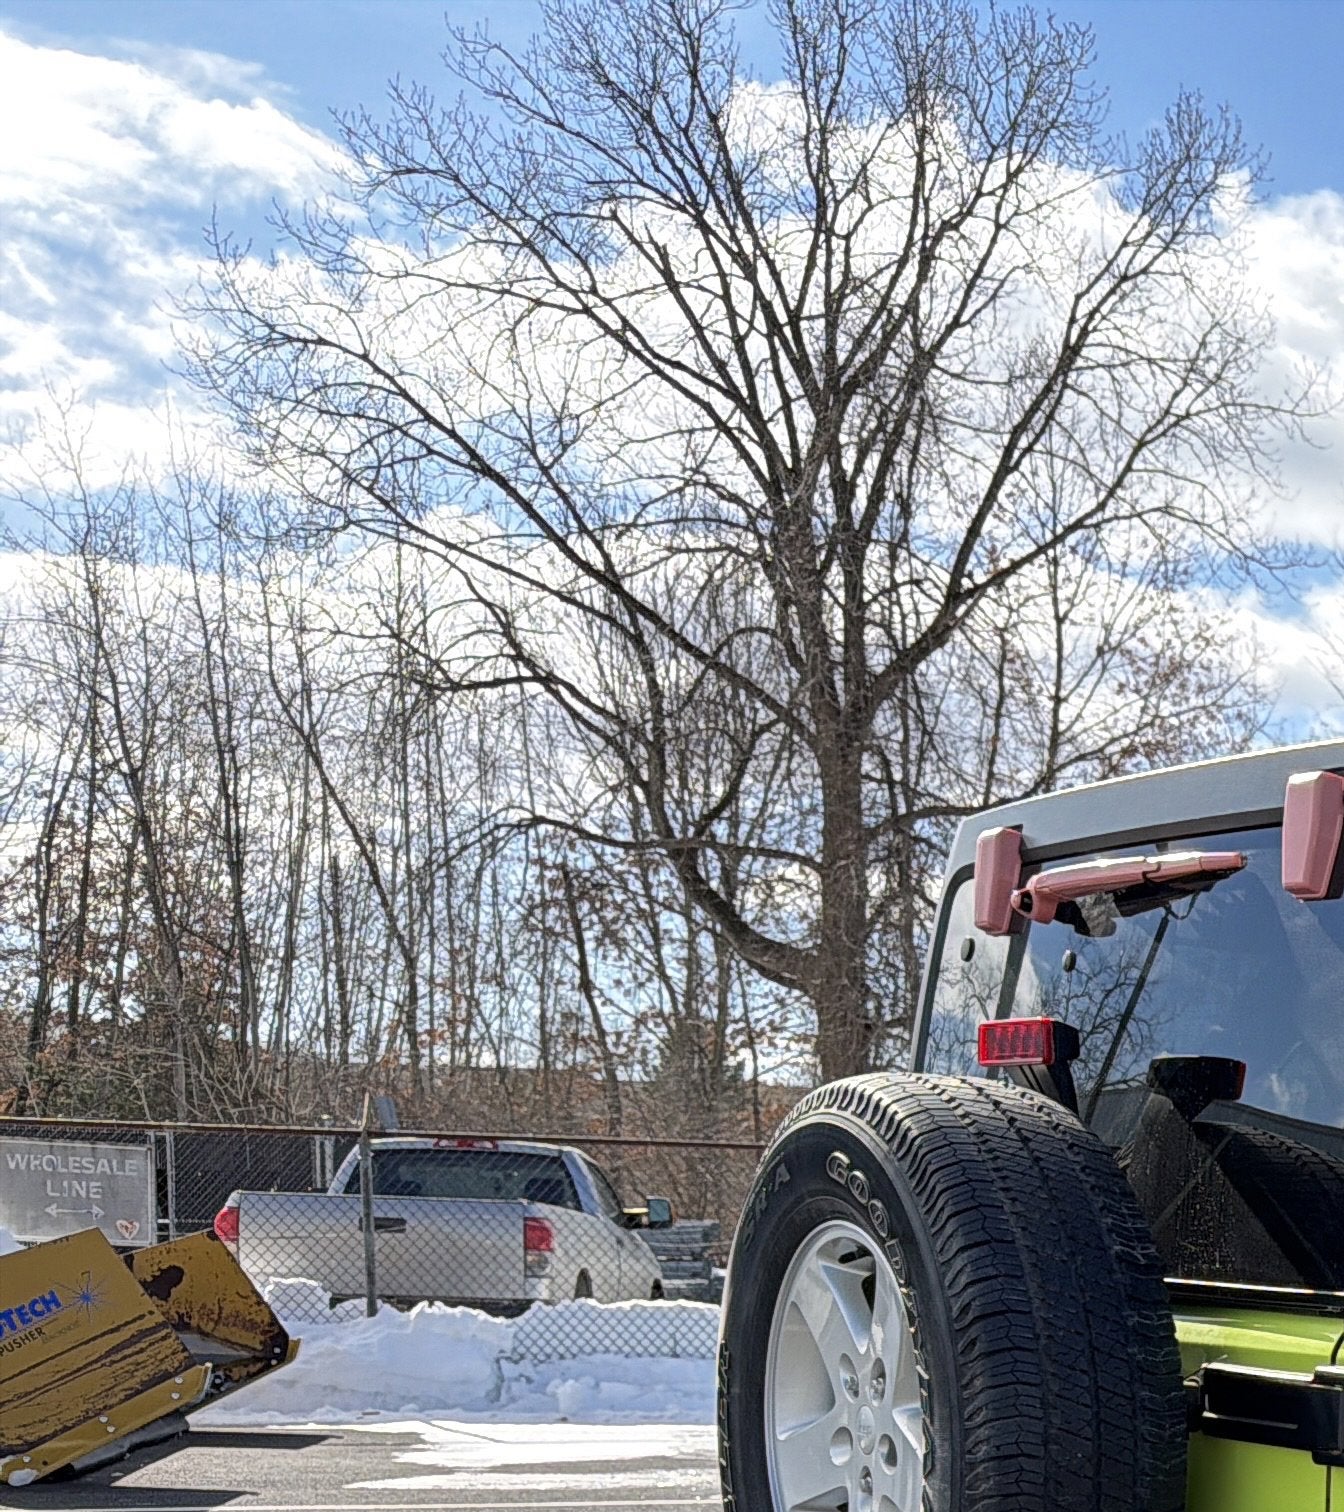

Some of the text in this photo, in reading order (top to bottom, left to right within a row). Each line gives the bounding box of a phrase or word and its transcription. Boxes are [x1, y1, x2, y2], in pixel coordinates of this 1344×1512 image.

[5, 1153, 138, 1176] WHOLESALE
[46, 1179, 103, 1199] LINE
[0, 1289, 62, 1338] TECH
